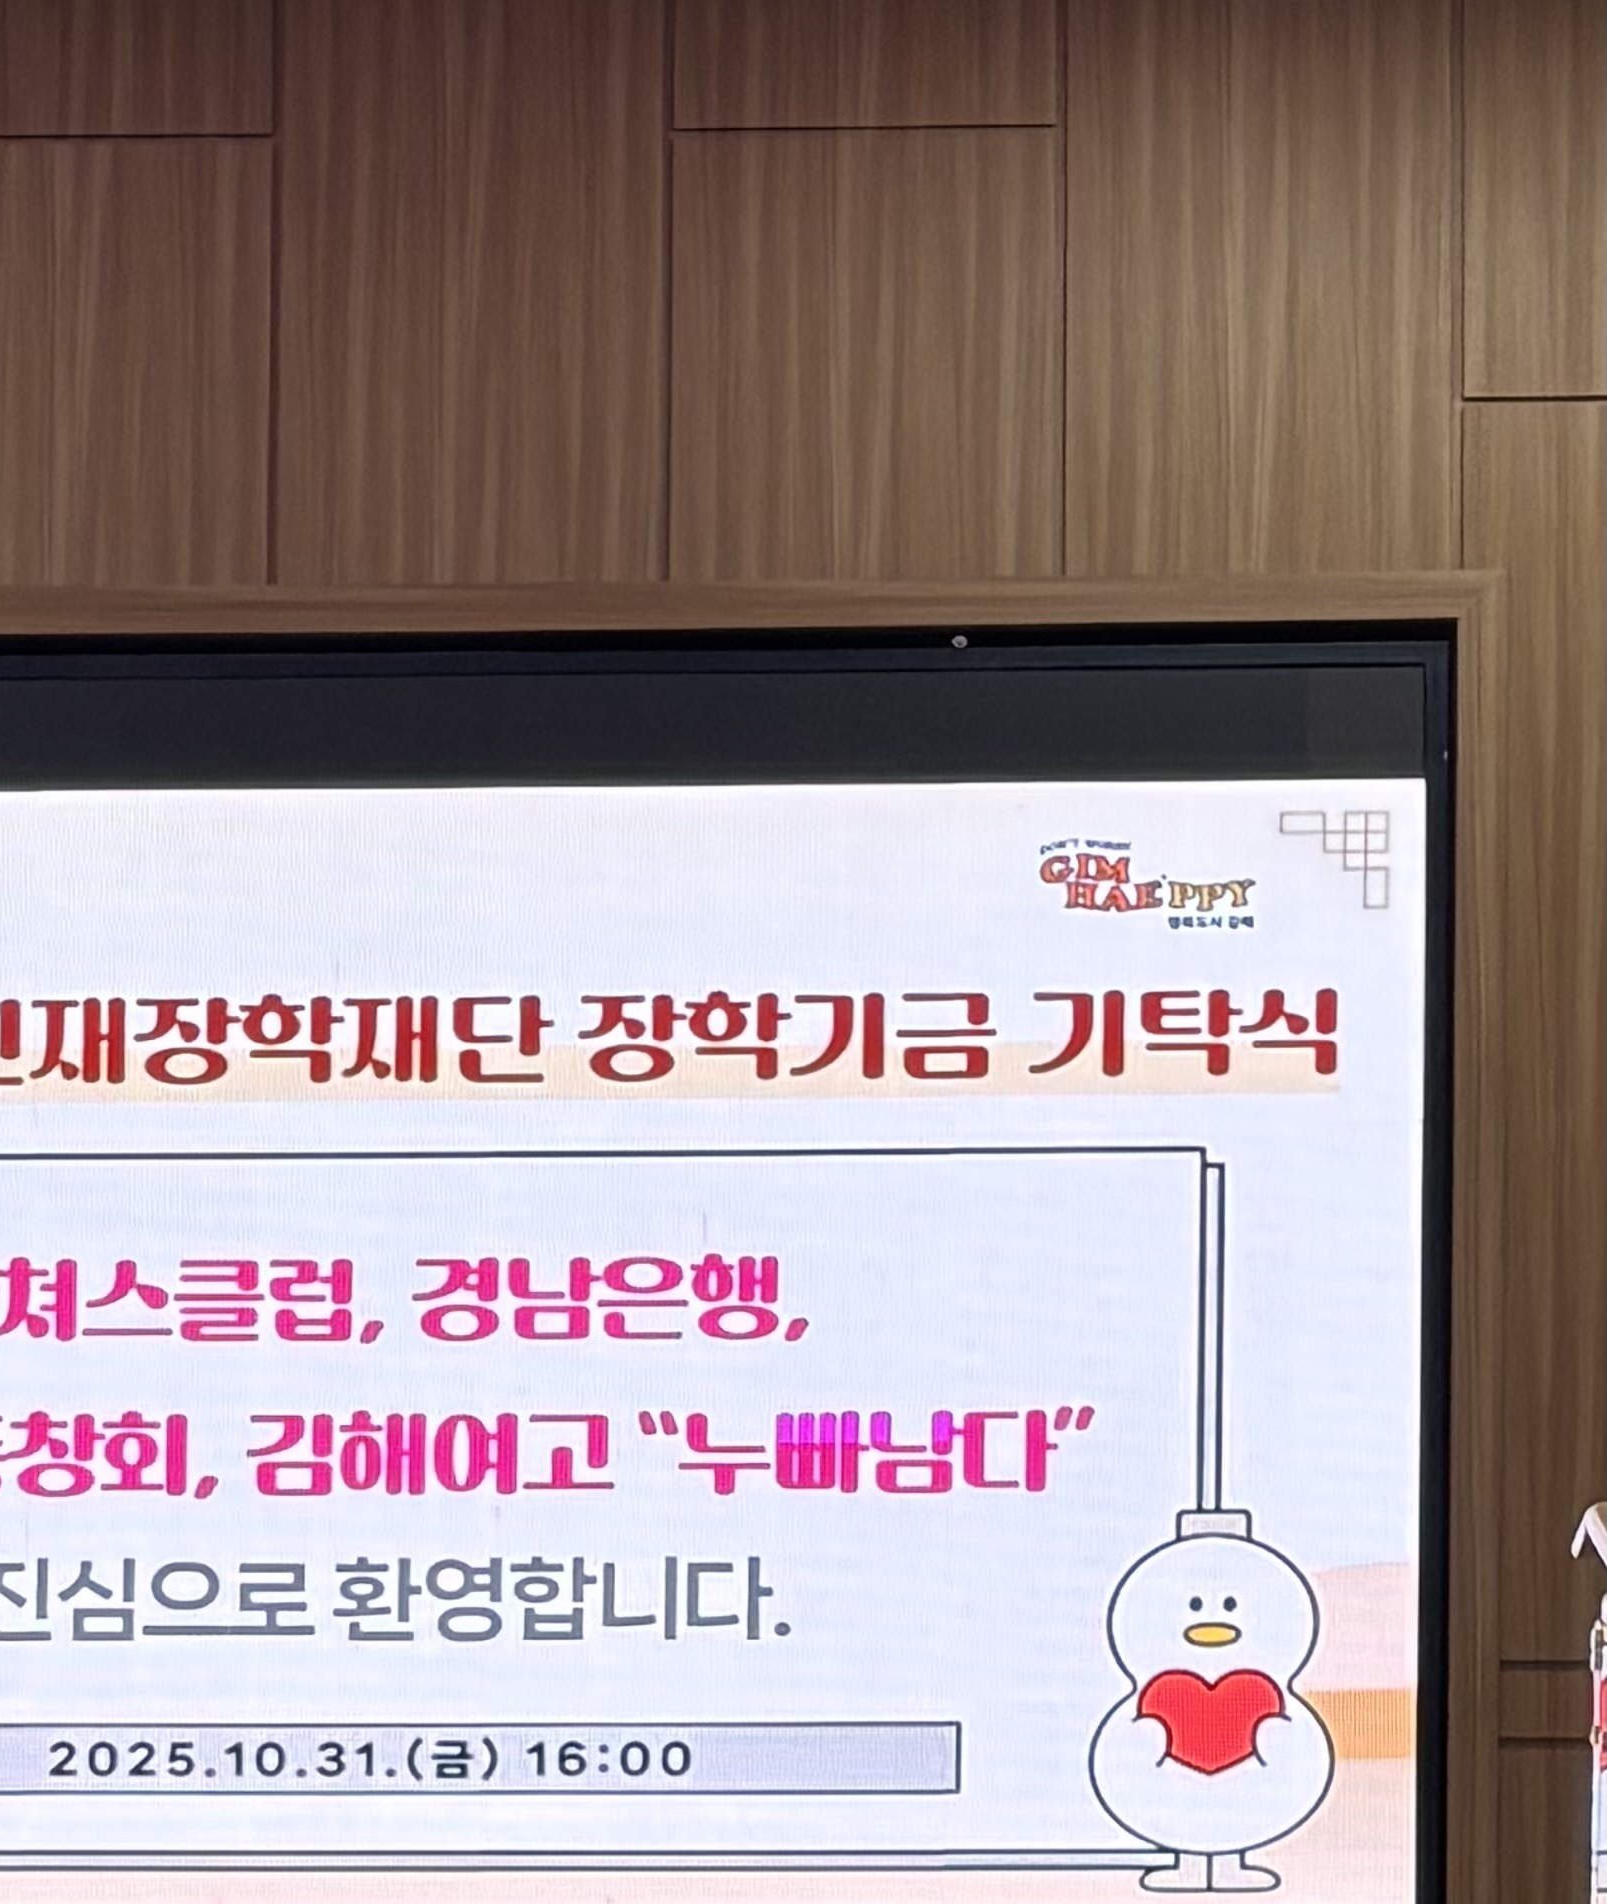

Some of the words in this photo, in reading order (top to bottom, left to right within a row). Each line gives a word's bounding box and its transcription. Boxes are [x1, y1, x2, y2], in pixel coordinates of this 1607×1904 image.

[1039, 852, 1131, 884] GIM
[577, 989, 998, 1084] 장학기금
[1028, 986, 1340, 1078] 기탁식
[412, 1253, 812, 1344] 경남은행,
[247, 1410, 615, 1497] 김해여고
[334, 1556, 792, 1643] 환영합니다.
[48, 1737, 500, 1781] 2025.10.31.(금)
[526, 1740, 692, 1777] 16:00
